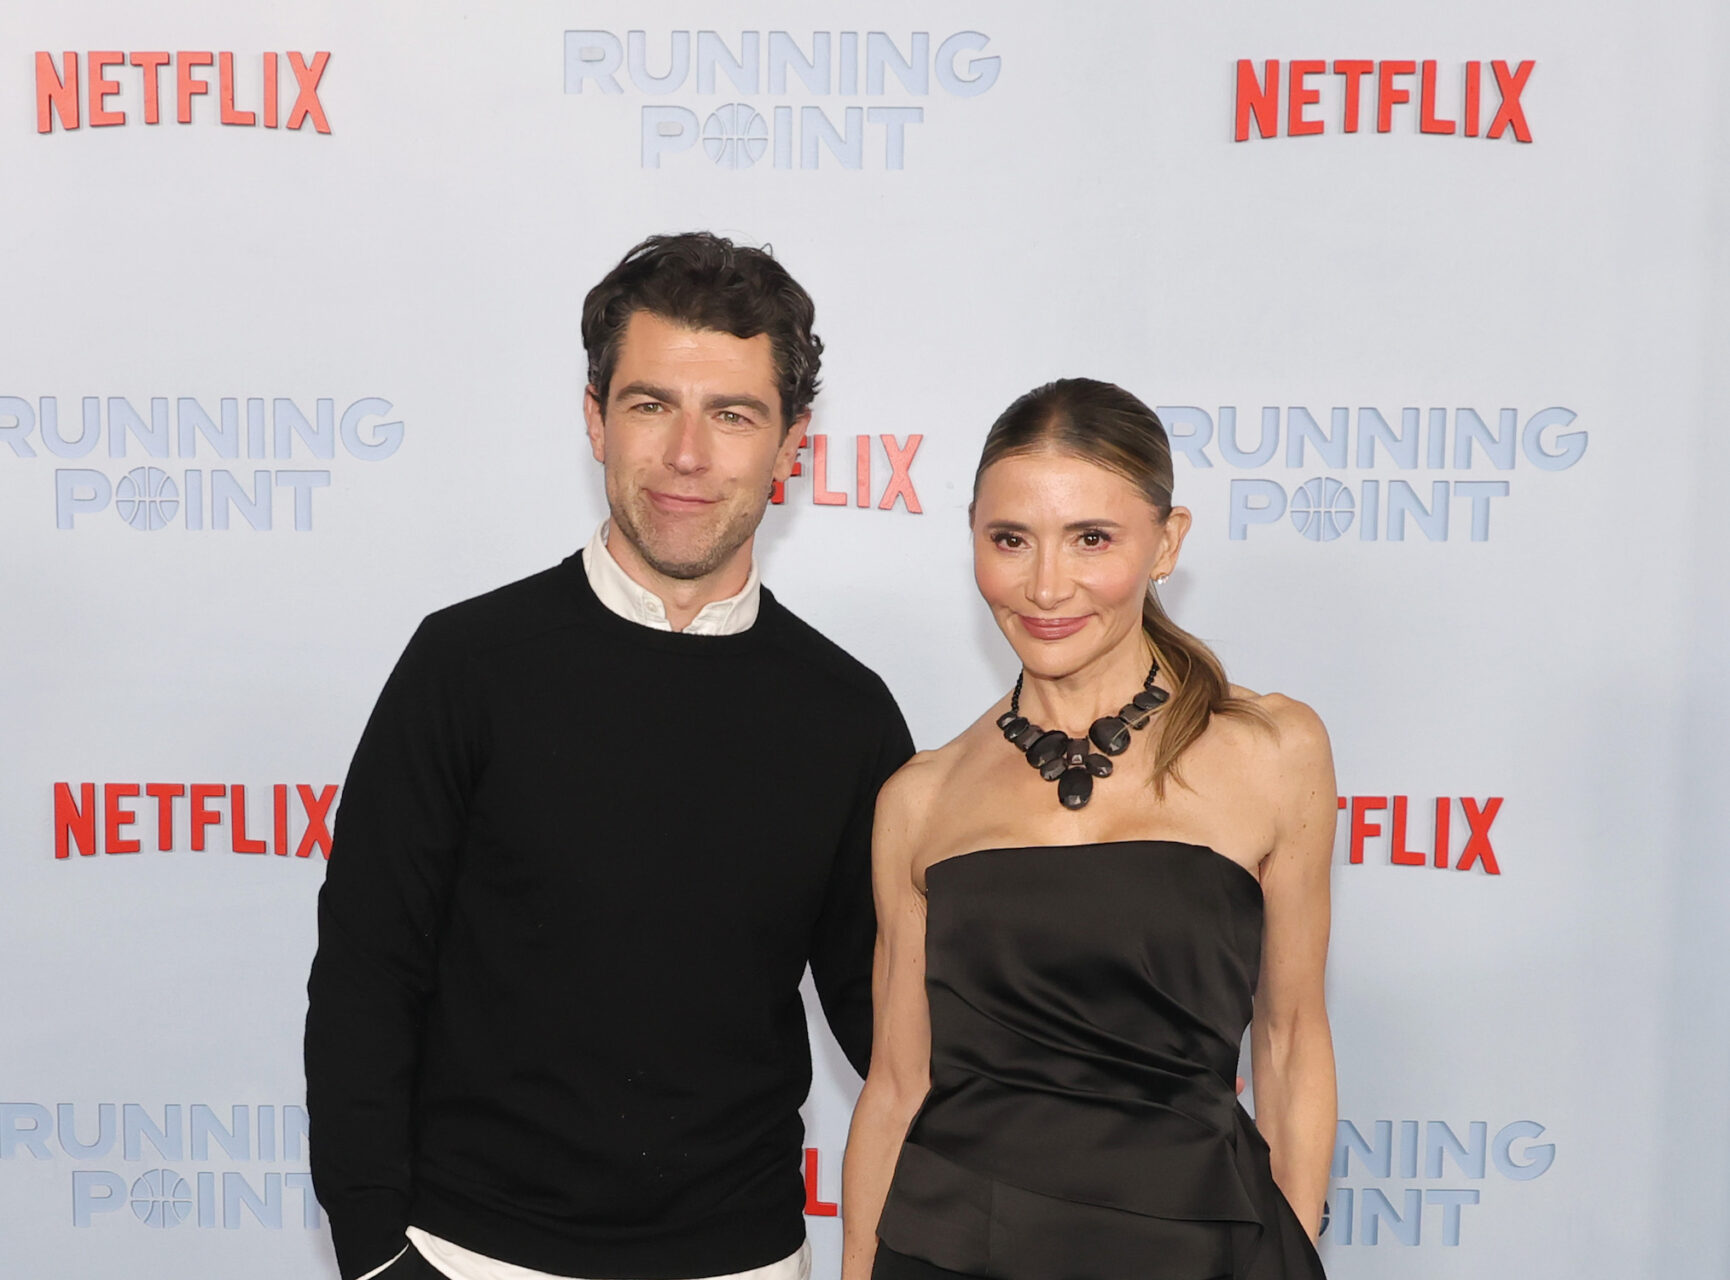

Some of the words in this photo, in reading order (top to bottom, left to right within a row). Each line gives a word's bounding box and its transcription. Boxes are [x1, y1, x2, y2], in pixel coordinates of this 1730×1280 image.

[35, 51, 331, 134] NETFLIX
[564, 30, 1001, 97] RUNNING
[1234, 59, 1536, 143] NETFLIX
[641, 103, 924, 170] POINT
[0, 396, 404, 461] RUNNING
[1156, 406, 1588, 471] RUNNING
[55, 466, 331, 531] POINT
[1229, 476, 1510, 542] POINT
[54, 782, 339, 860] NETFLIX
[72, 1168, 321, 1229] POINT
[1319, 1187, 1480, 1246] INT
